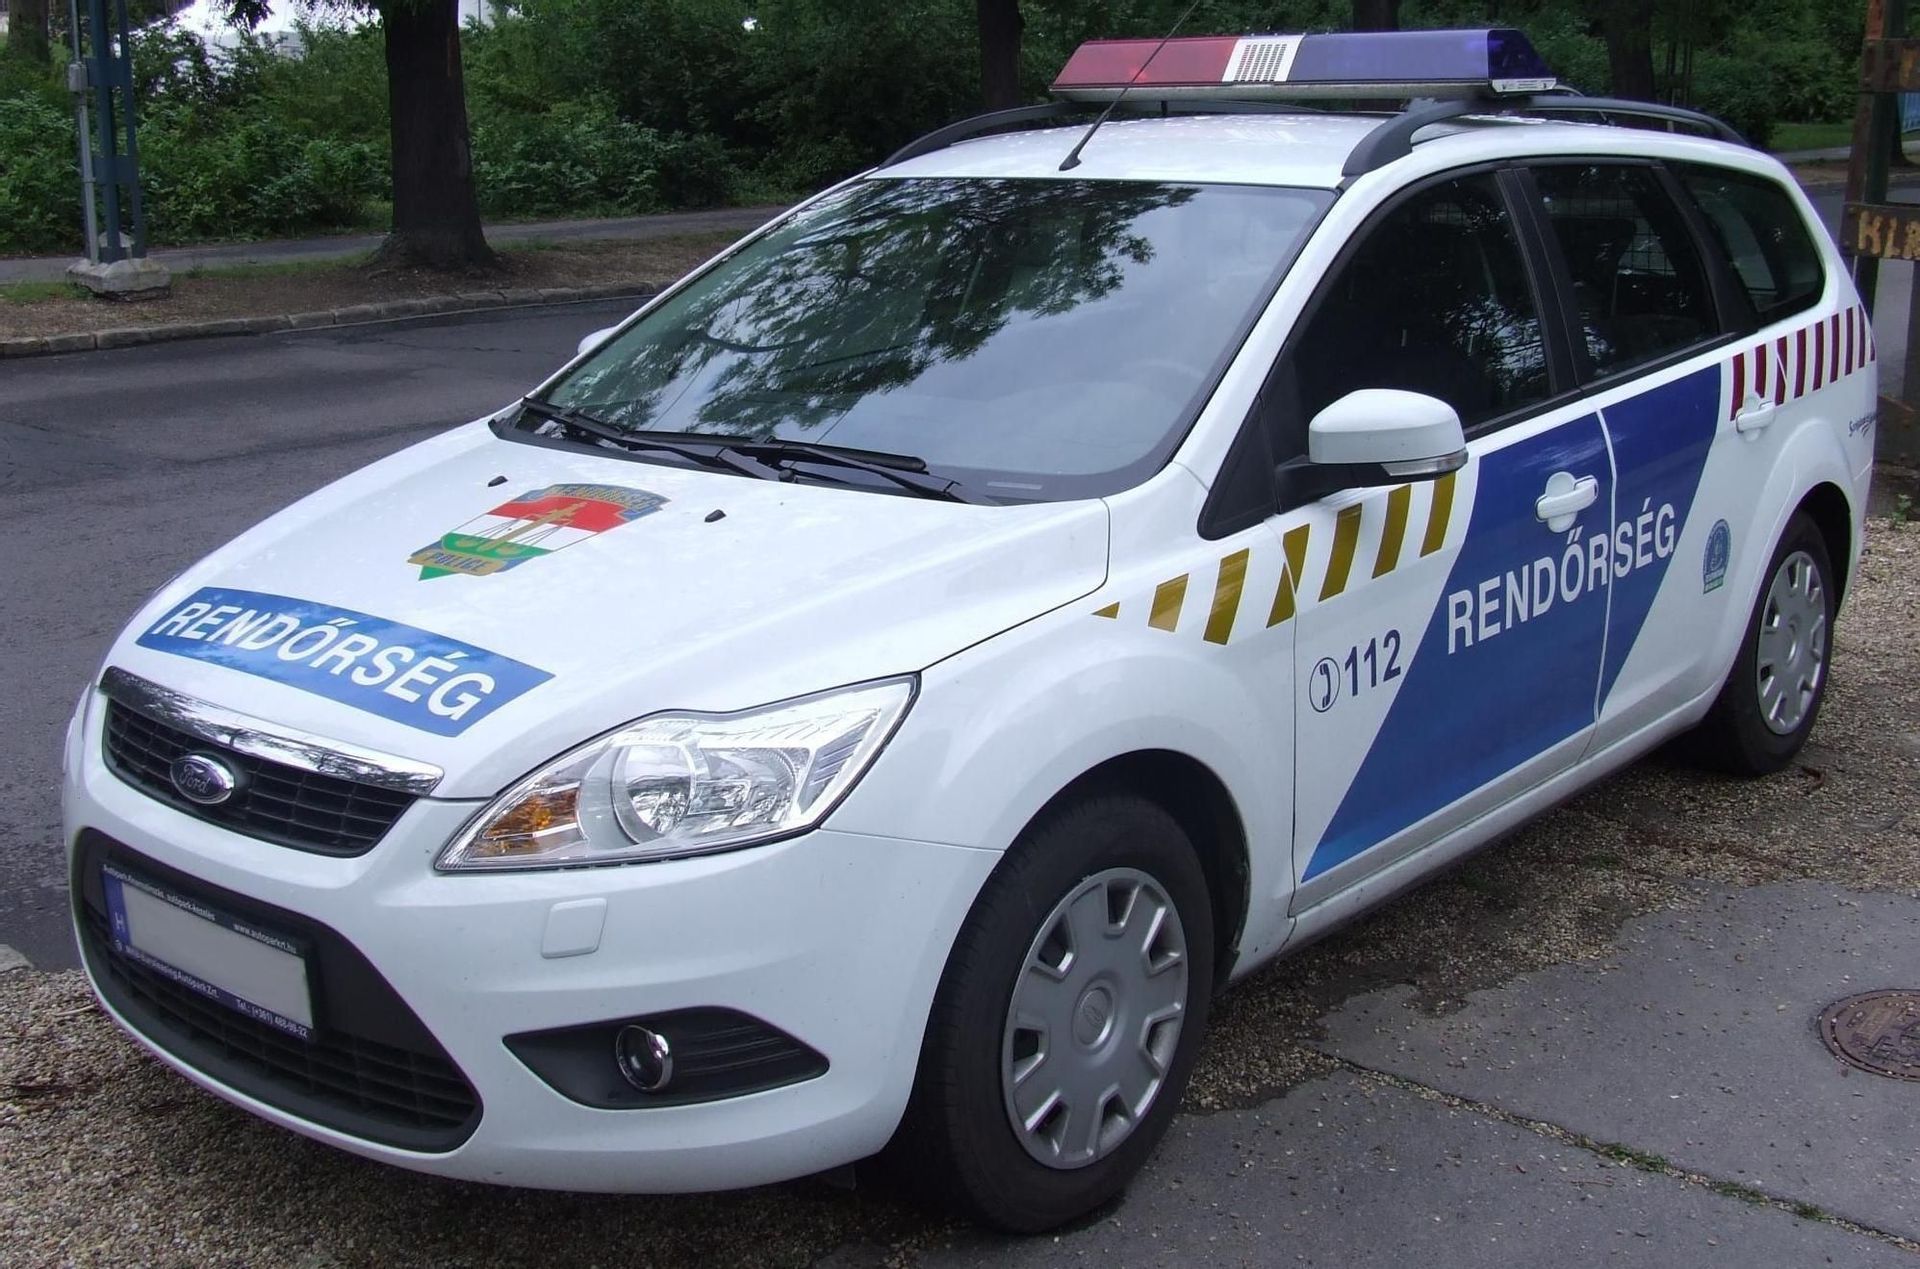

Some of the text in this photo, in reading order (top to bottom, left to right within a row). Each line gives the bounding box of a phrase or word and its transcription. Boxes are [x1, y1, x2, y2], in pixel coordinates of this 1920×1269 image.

[427, 552, 490, 573] POLICE
[1447, 497, 1676, 655] RENDŐRSÉG
[151, 602, 496, 721] RENDŐRSÉG
[1344, 628, 1401, 697] 112
[179, 763, 211, 793] Ford
